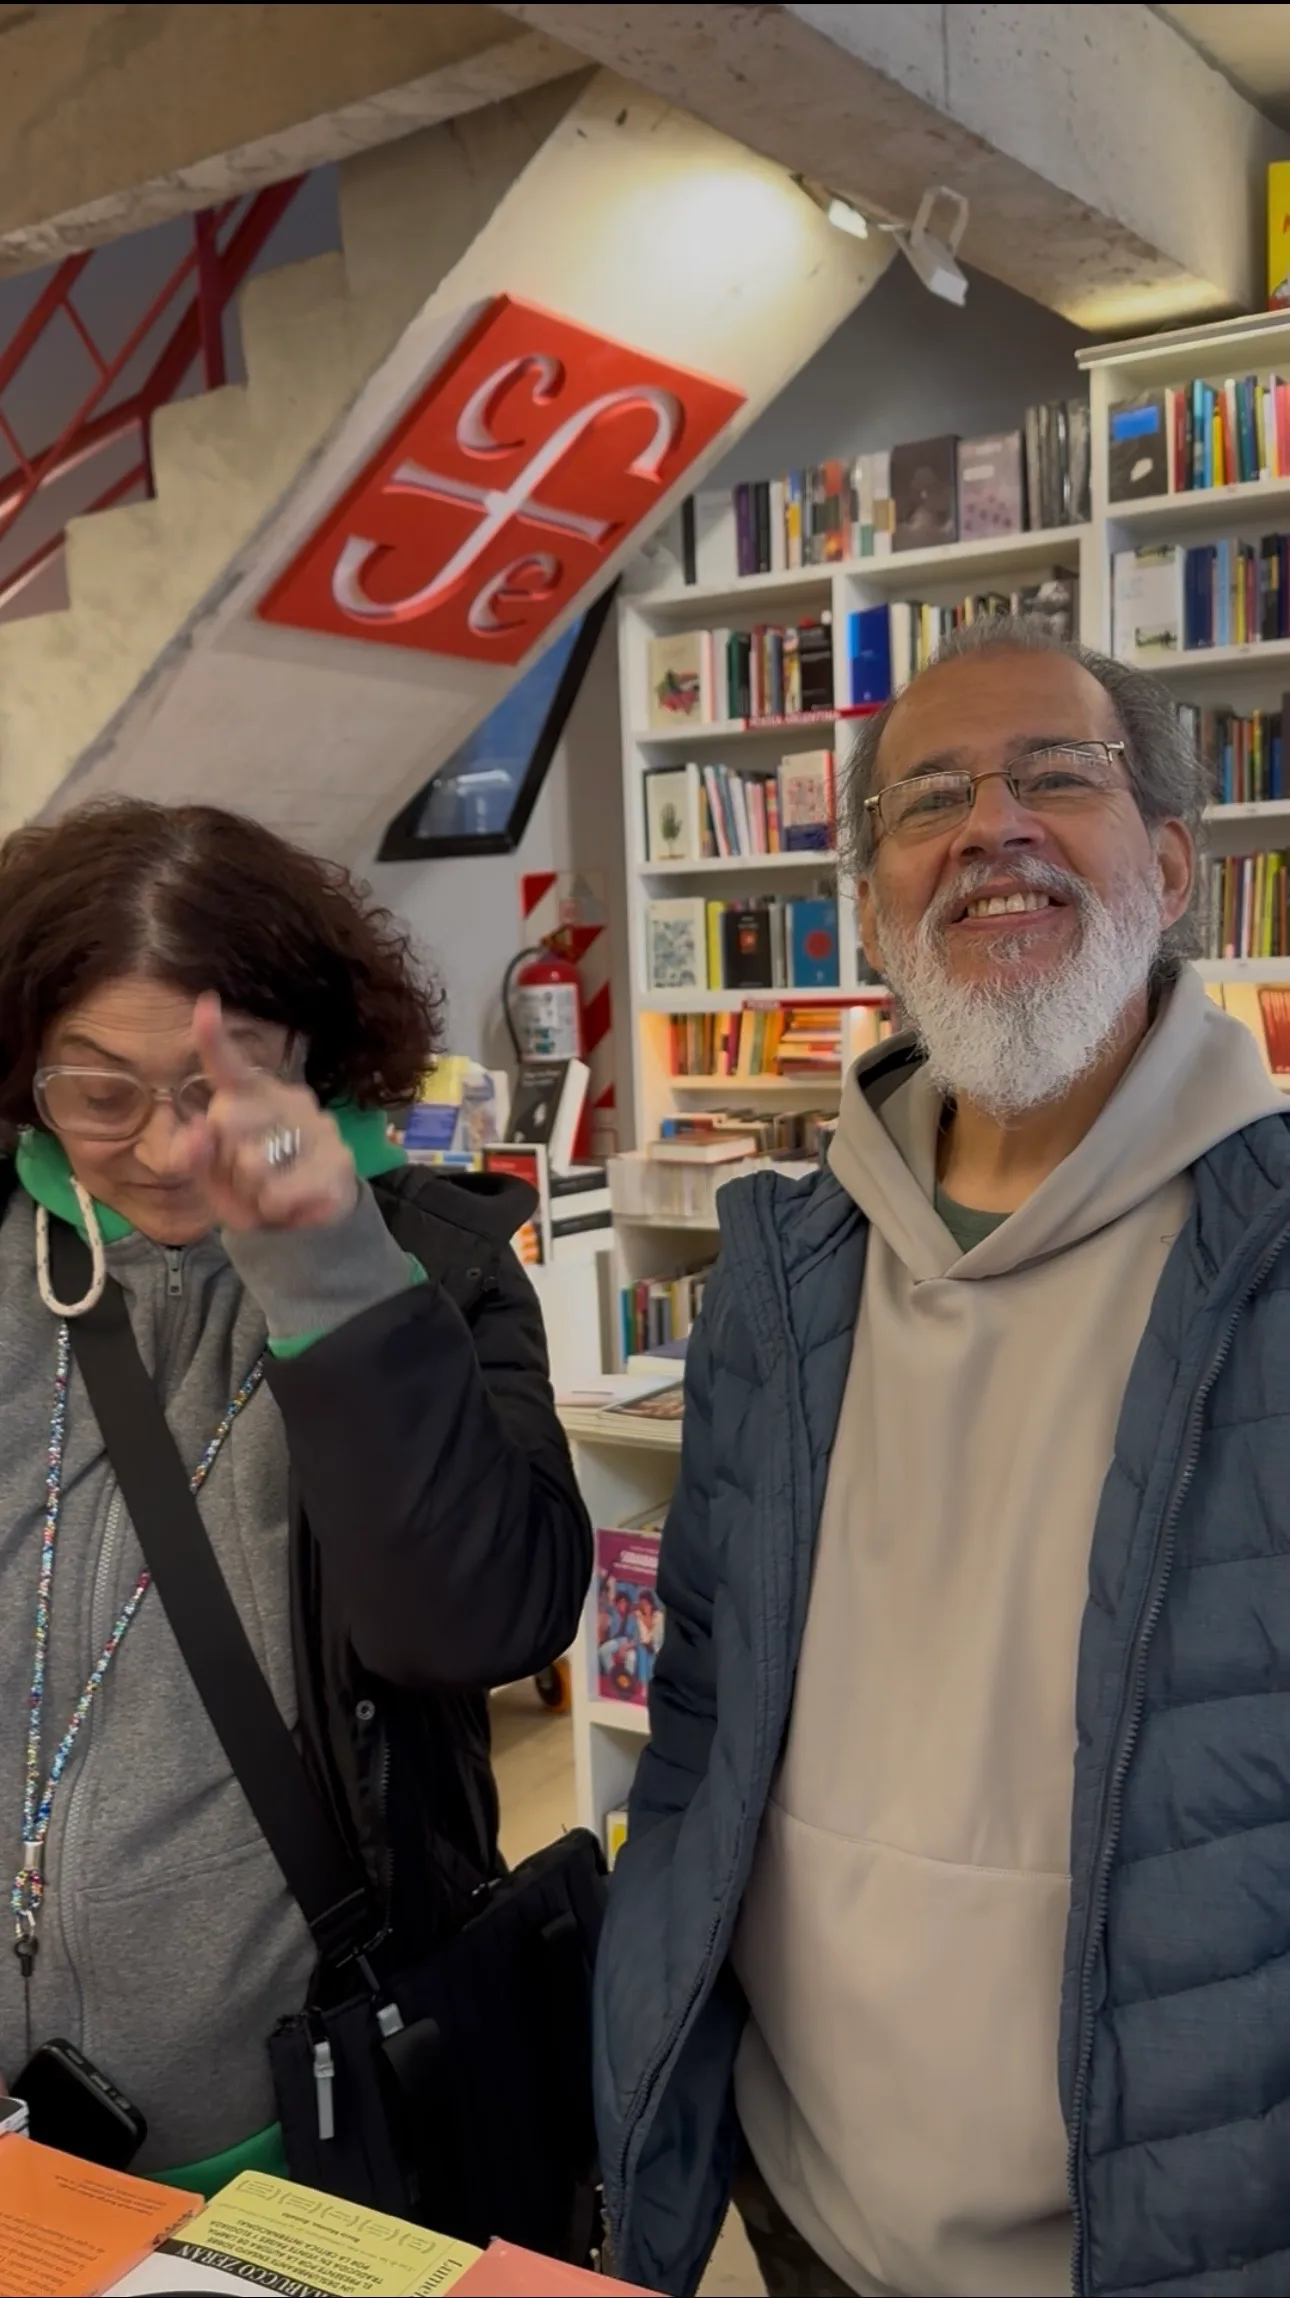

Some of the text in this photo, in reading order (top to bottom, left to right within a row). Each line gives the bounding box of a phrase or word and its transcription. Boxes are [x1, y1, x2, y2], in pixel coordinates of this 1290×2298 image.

[210, 2220, 252, 2237] ELOGIADA
[236, 2220, 304, 2246] INTERNACIONAL
[236, 2238, 250, 2246] DE
[250, 2242, 286, 2258] AUTORA
[290, 2246, 320, 2260] VEINTE
[208, 2238, 355, 2293] UN DESLUMBRANTE ENSAYO SOBRE
[297, 2260, 317, 2270] POR
[320, 2258, 332, 2266] EN
[350, 2260, 370, 2270] POR
[318, 2266, 361, 2286] PRESENTE
[332, 2263, 384, 2284] TRADUCIDA
[362, 2282, 372, 2290] EL
